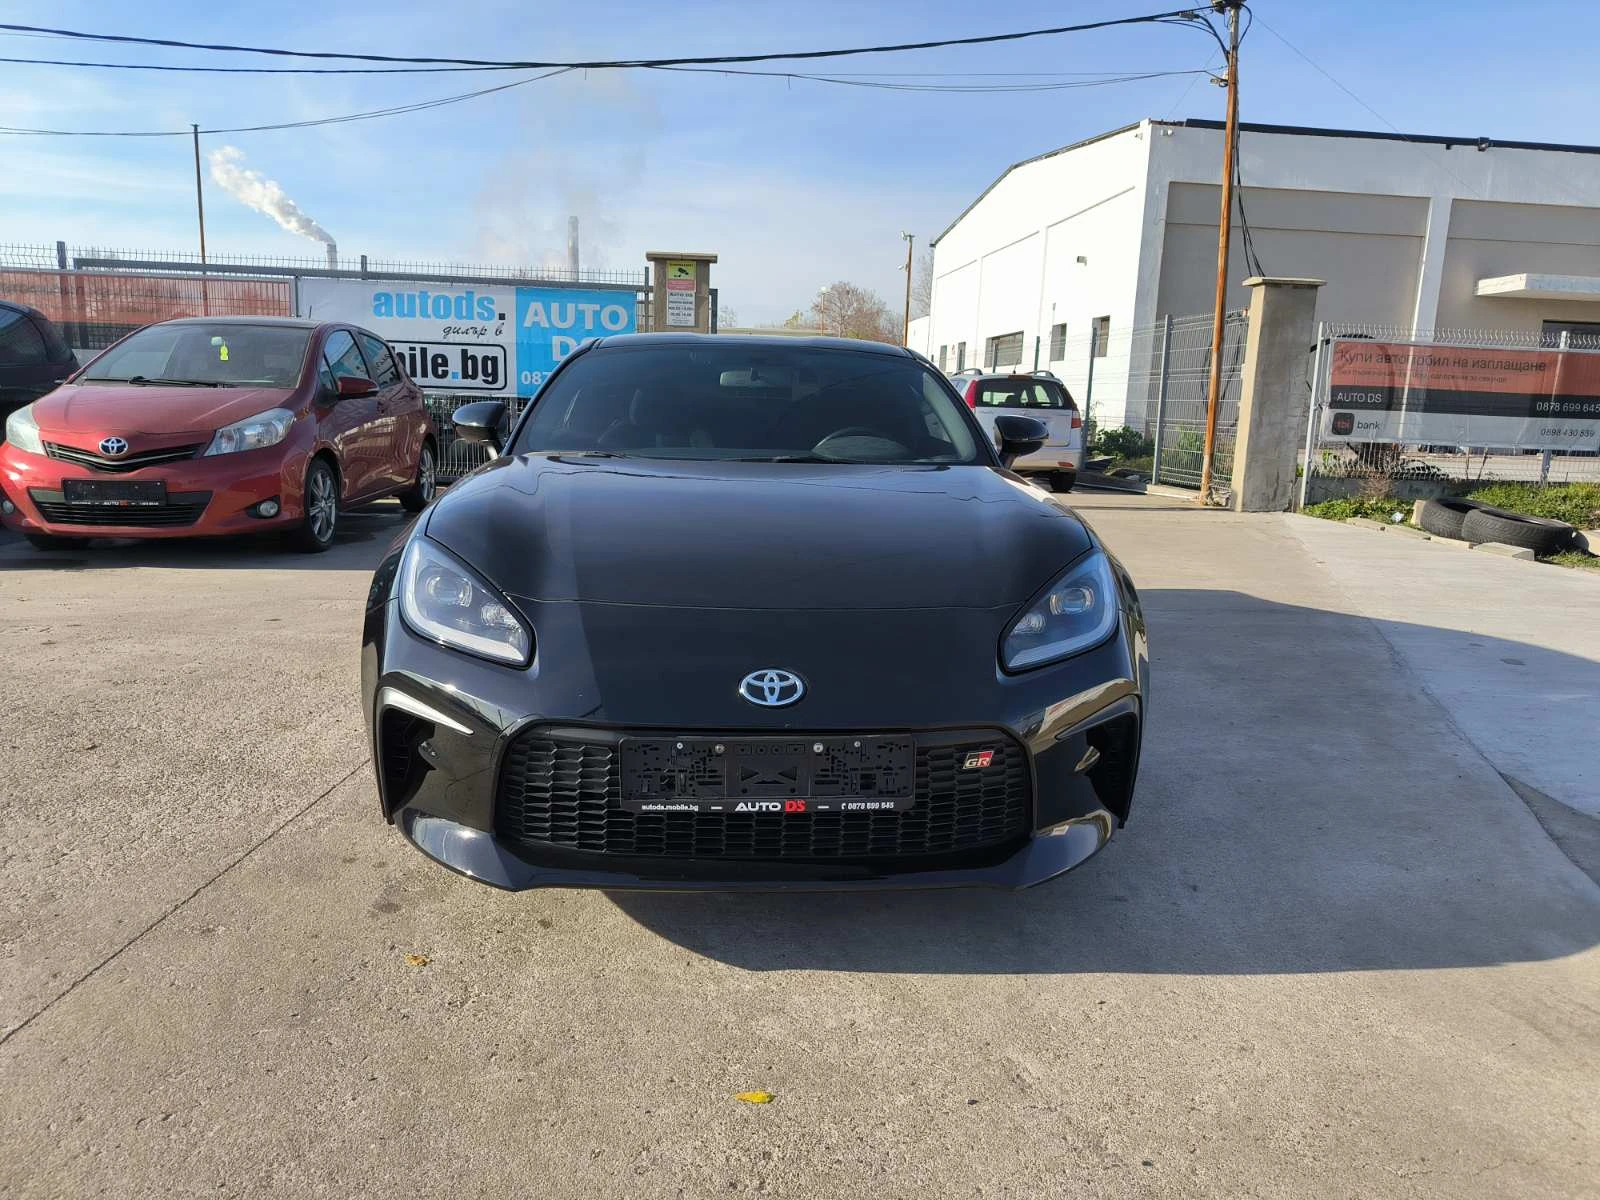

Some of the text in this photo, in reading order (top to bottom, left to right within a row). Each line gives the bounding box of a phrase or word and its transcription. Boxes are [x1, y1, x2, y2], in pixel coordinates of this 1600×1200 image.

[523, 302, 629, 331] AUTO
[1340, 352, 1372, 365] Купи
[1453, 358, 1468, 369] на
[1472, 359, 1546, 372] изплащане
[1336, 392, 1382, 403] AUTO DS
[1536, 401, 1560, 412] 0878
[1562, 402, 1580, 412] 699
[1357, 420, 1380, 430] bank
[964, 758, 991, 768] GR
[735, 800, 805, 812] AUTO DS
